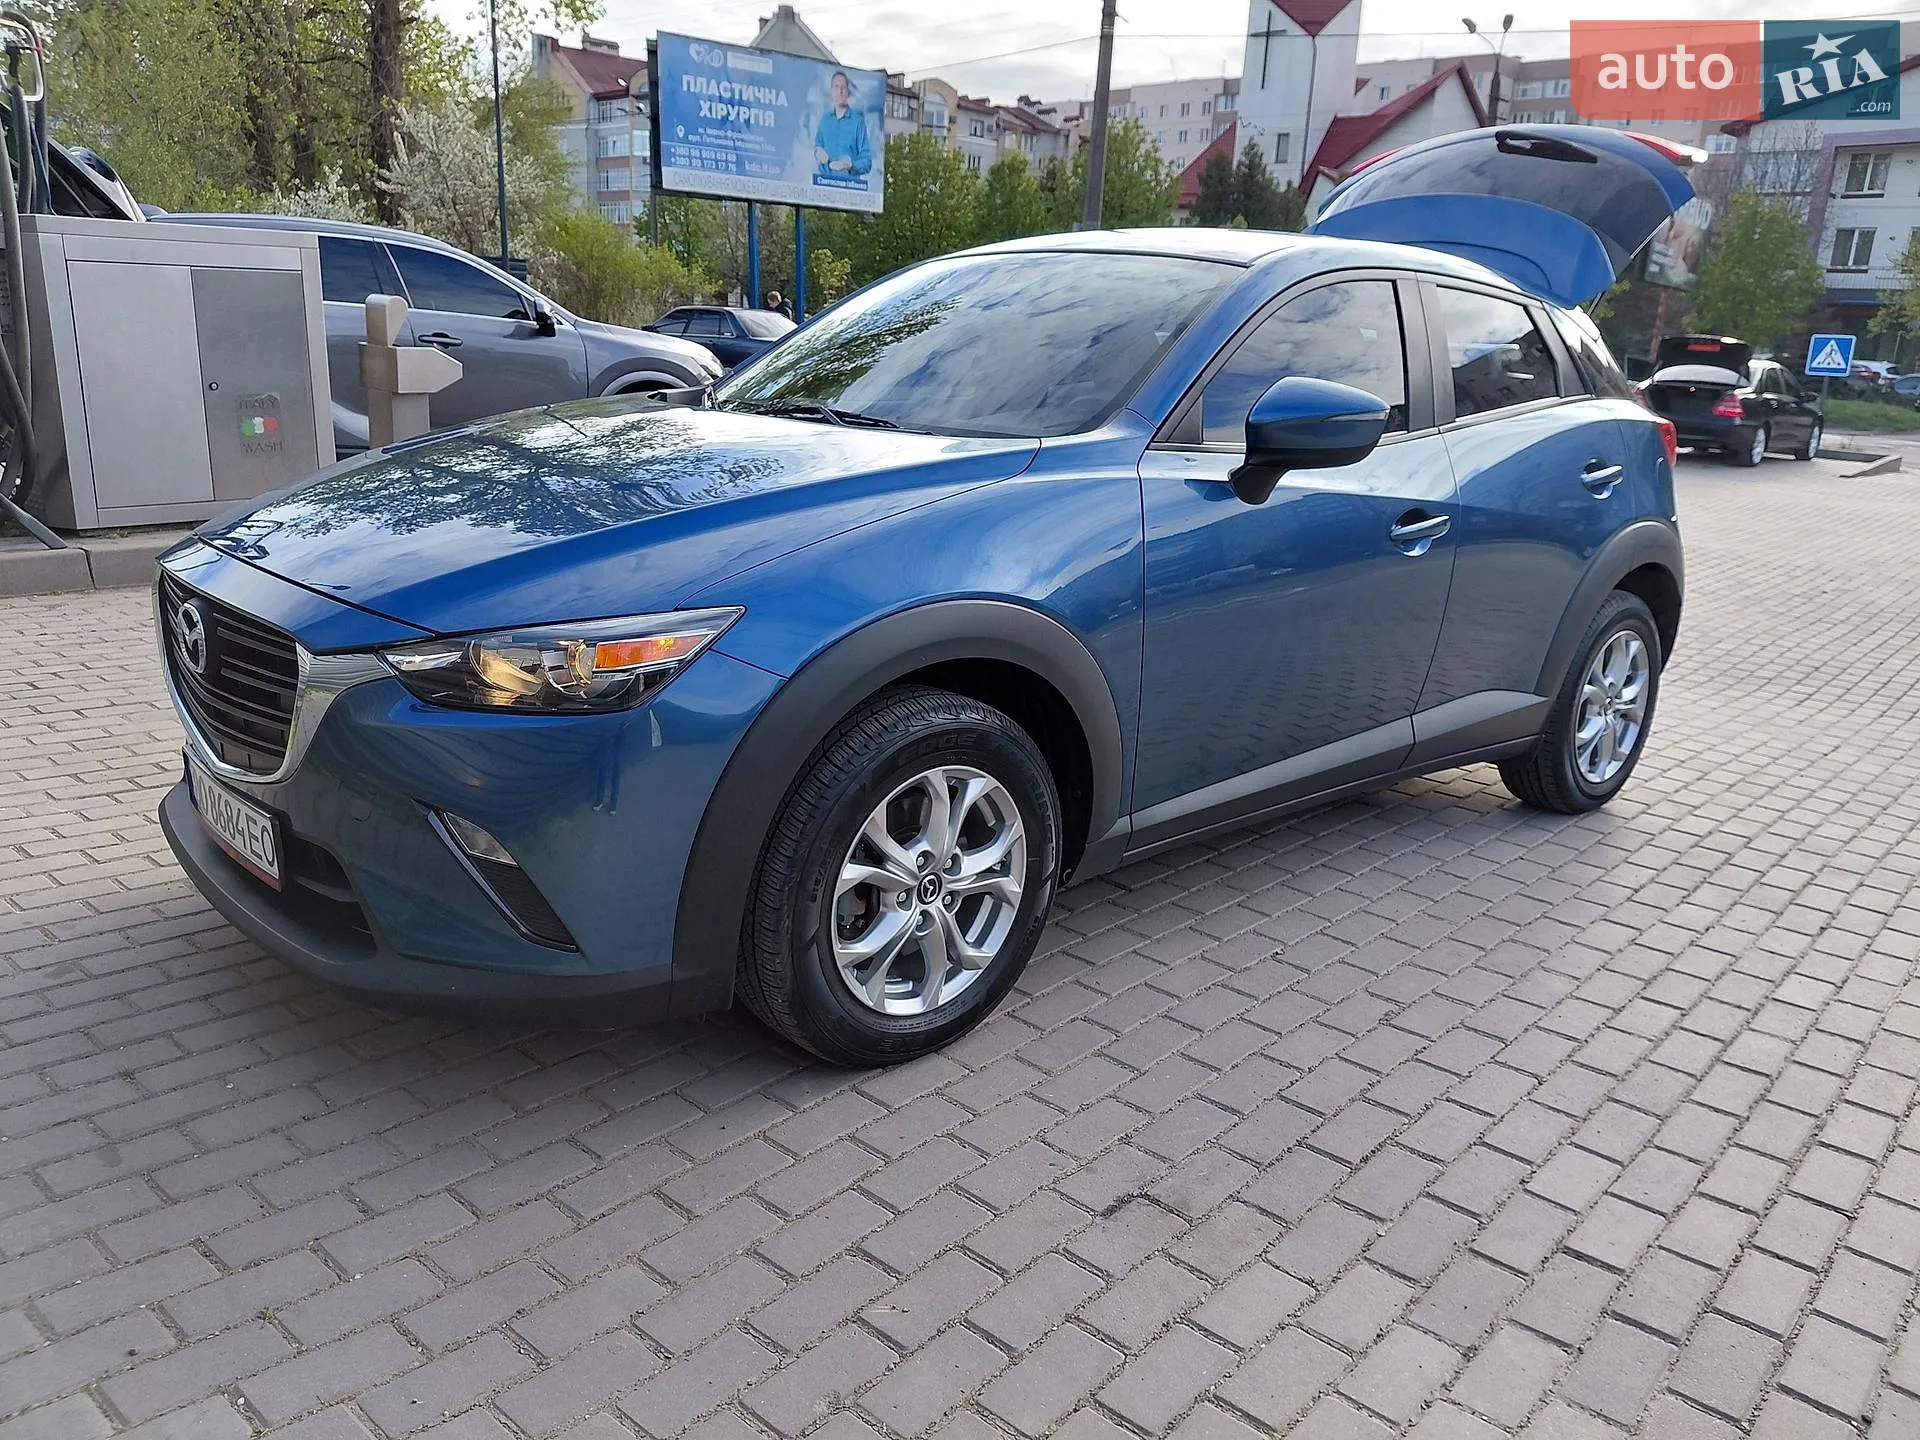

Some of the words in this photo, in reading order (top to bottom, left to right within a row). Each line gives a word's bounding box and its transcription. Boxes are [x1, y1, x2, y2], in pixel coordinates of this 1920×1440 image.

[682, 75, 788, 107] ПЛАСТИЧНА
[699, 100, 775, 127] ХІРУРГІЯ
[239, 397, 277, 410] ITALY
[241, 440, 284, 454] WASH
